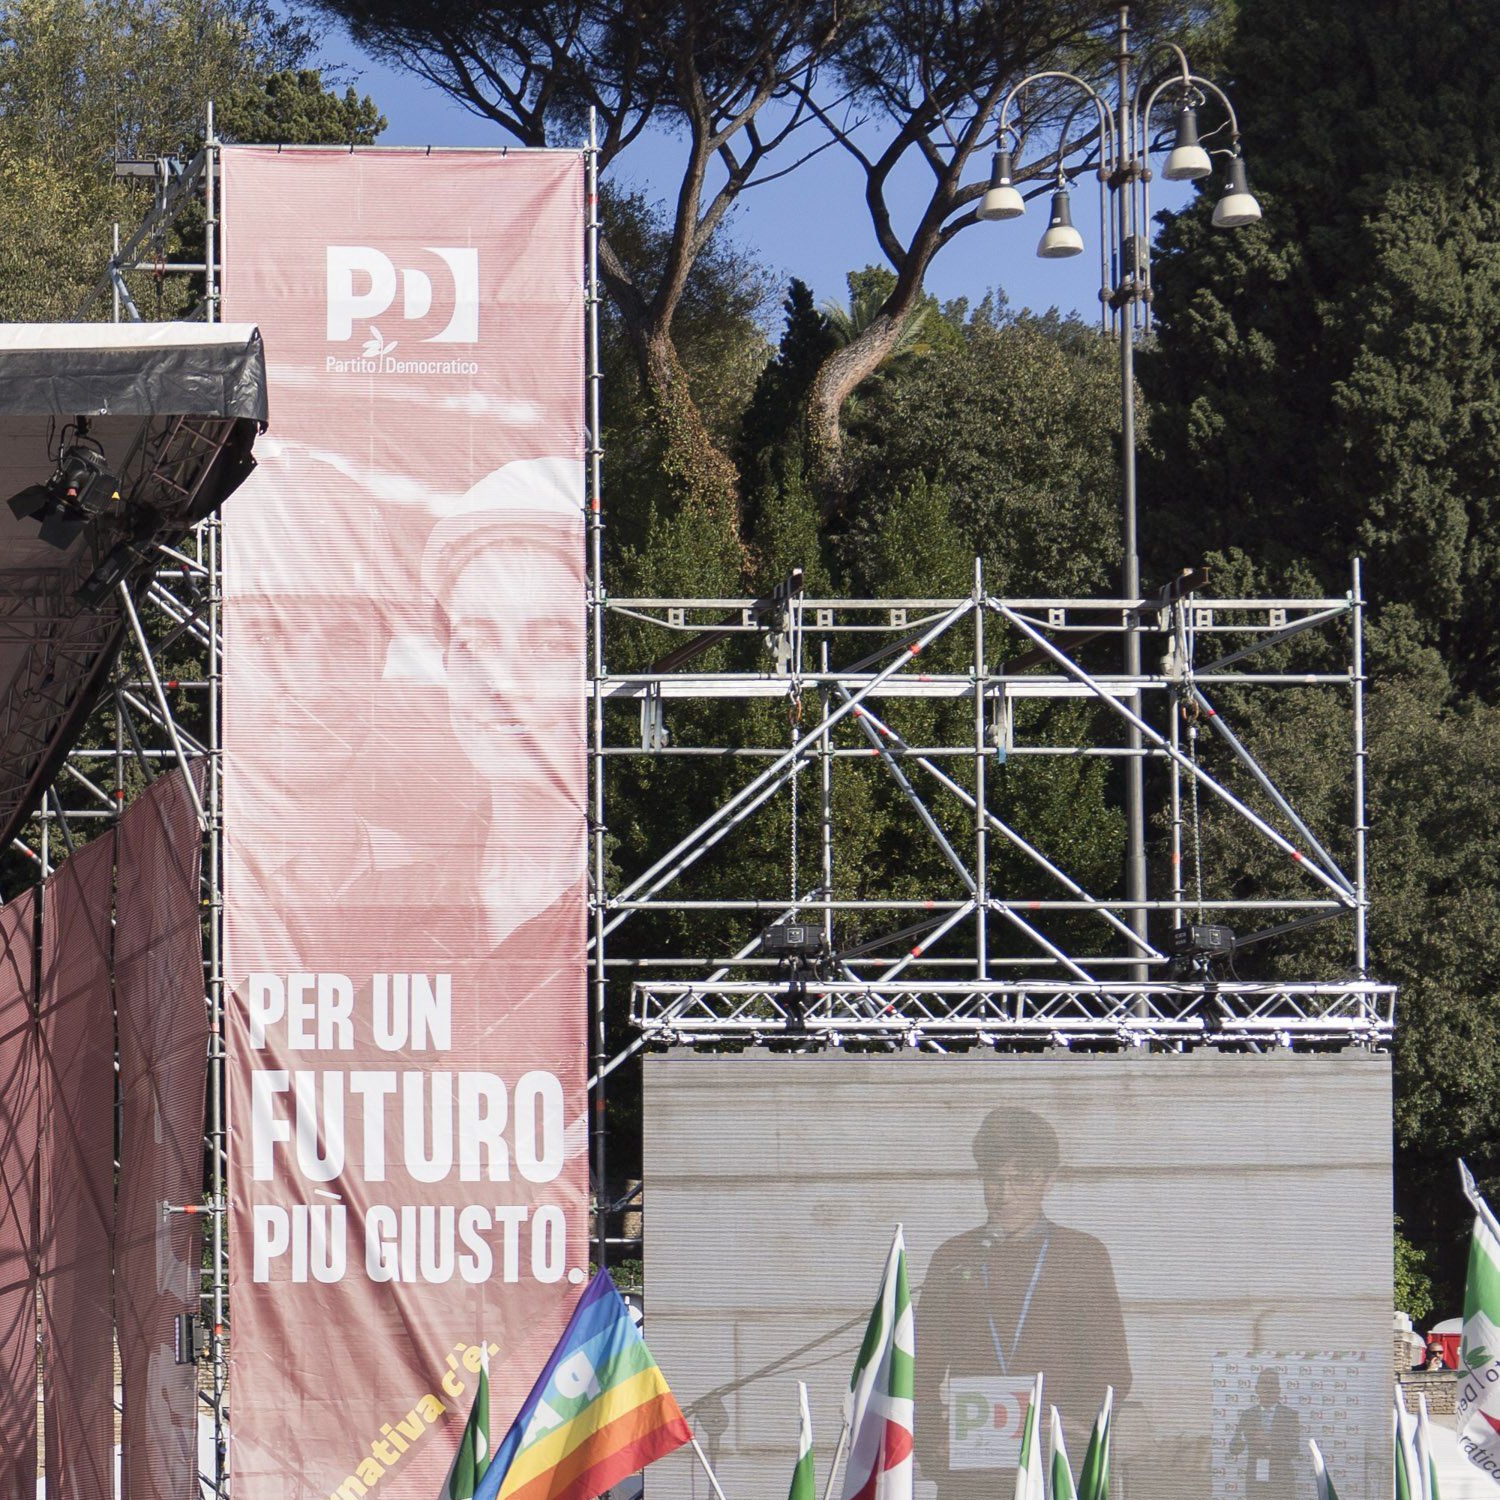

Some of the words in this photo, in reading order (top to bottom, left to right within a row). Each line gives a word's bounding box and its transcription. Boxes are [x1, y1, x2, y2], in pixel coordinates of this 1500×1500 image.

[327, 245, 479, 343] PD
[326, 357, 376, 373] Partito
[386, 357, 479, 375] Democratico
[249, 973, 355, 1050] PER
[373, 973, 452, 1051] UN
[252, 1070, 565, 1183] FUTURO
[253, 1189, 347, 1284] PIÙ
[365, 1205, 585, 1285] GIUSTO.
